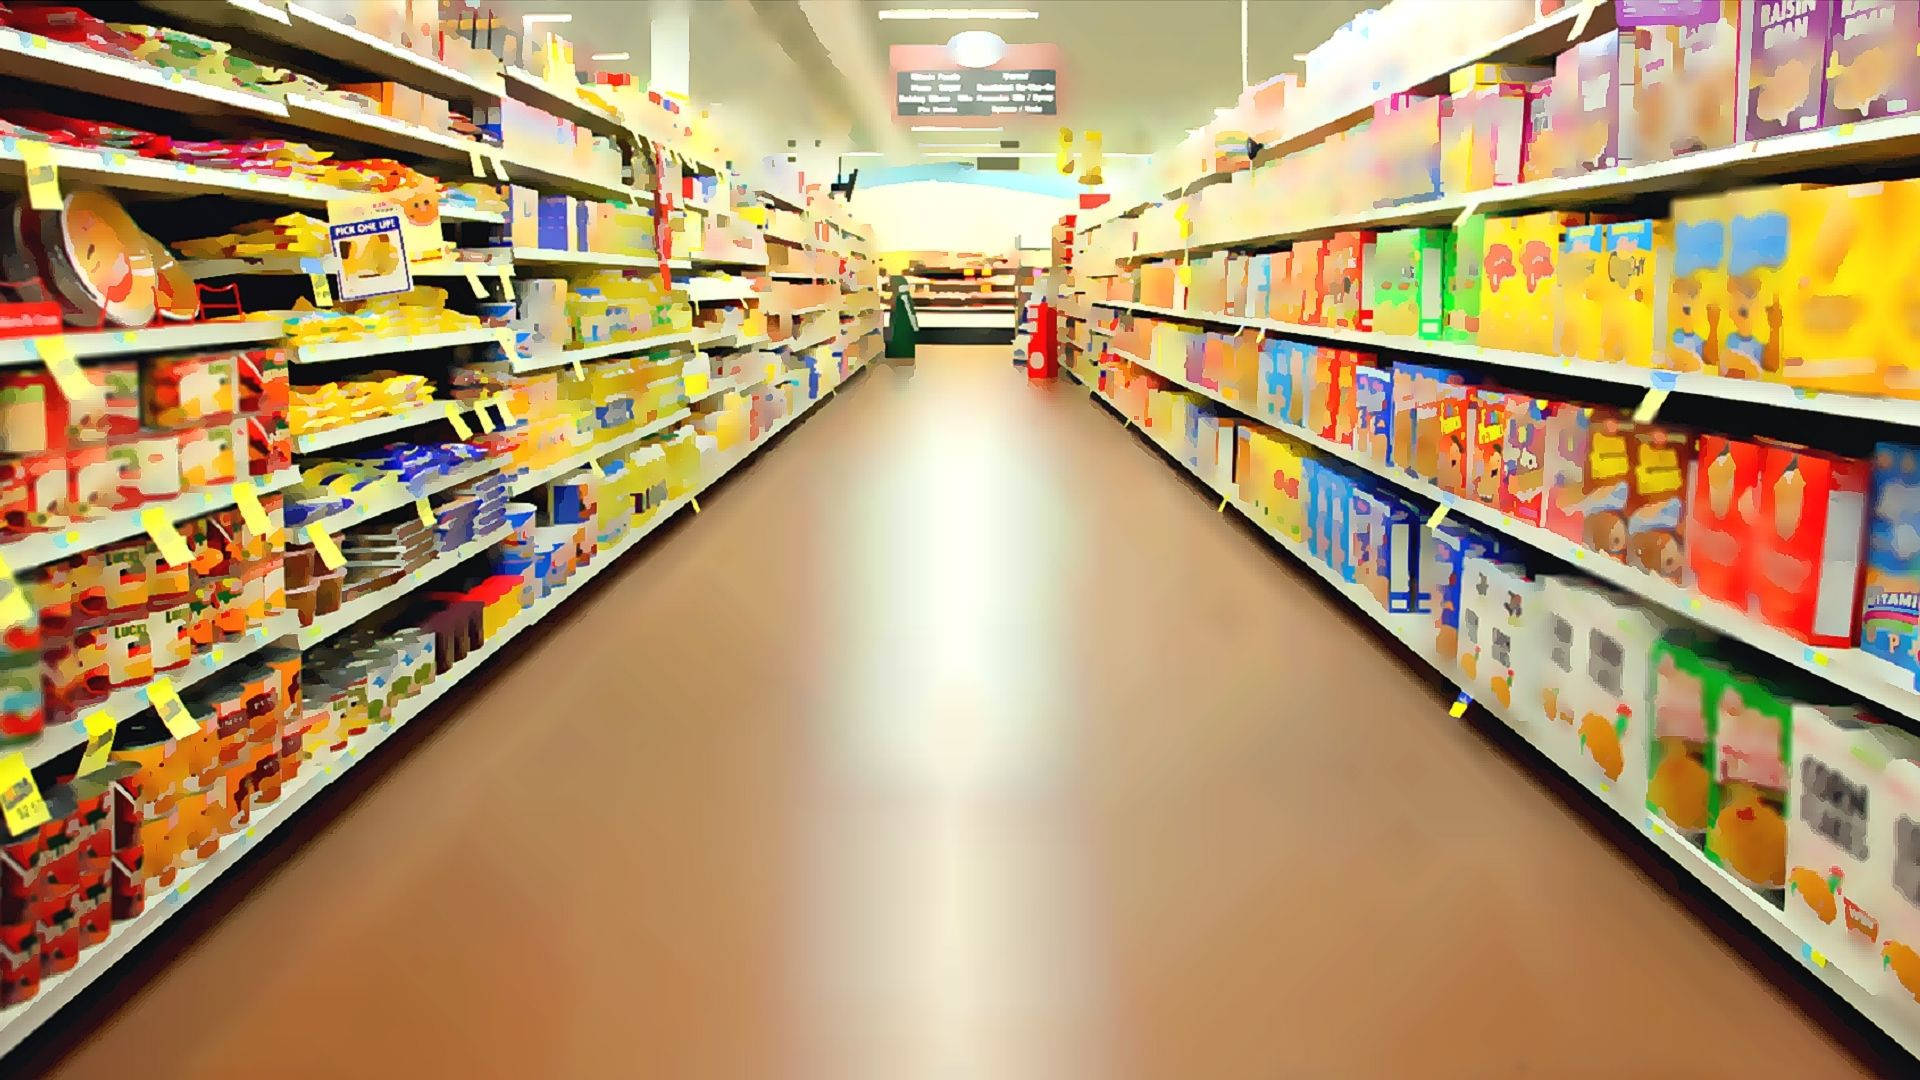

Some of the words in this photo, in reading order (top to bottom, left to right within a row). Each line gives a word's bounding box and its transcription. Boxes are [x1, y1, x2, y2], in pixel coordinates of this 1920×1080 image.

[335, 224, 356, 236] PICK
[358, 222, 377, 234] ONE
[380, 218, 396, 229] UP!
